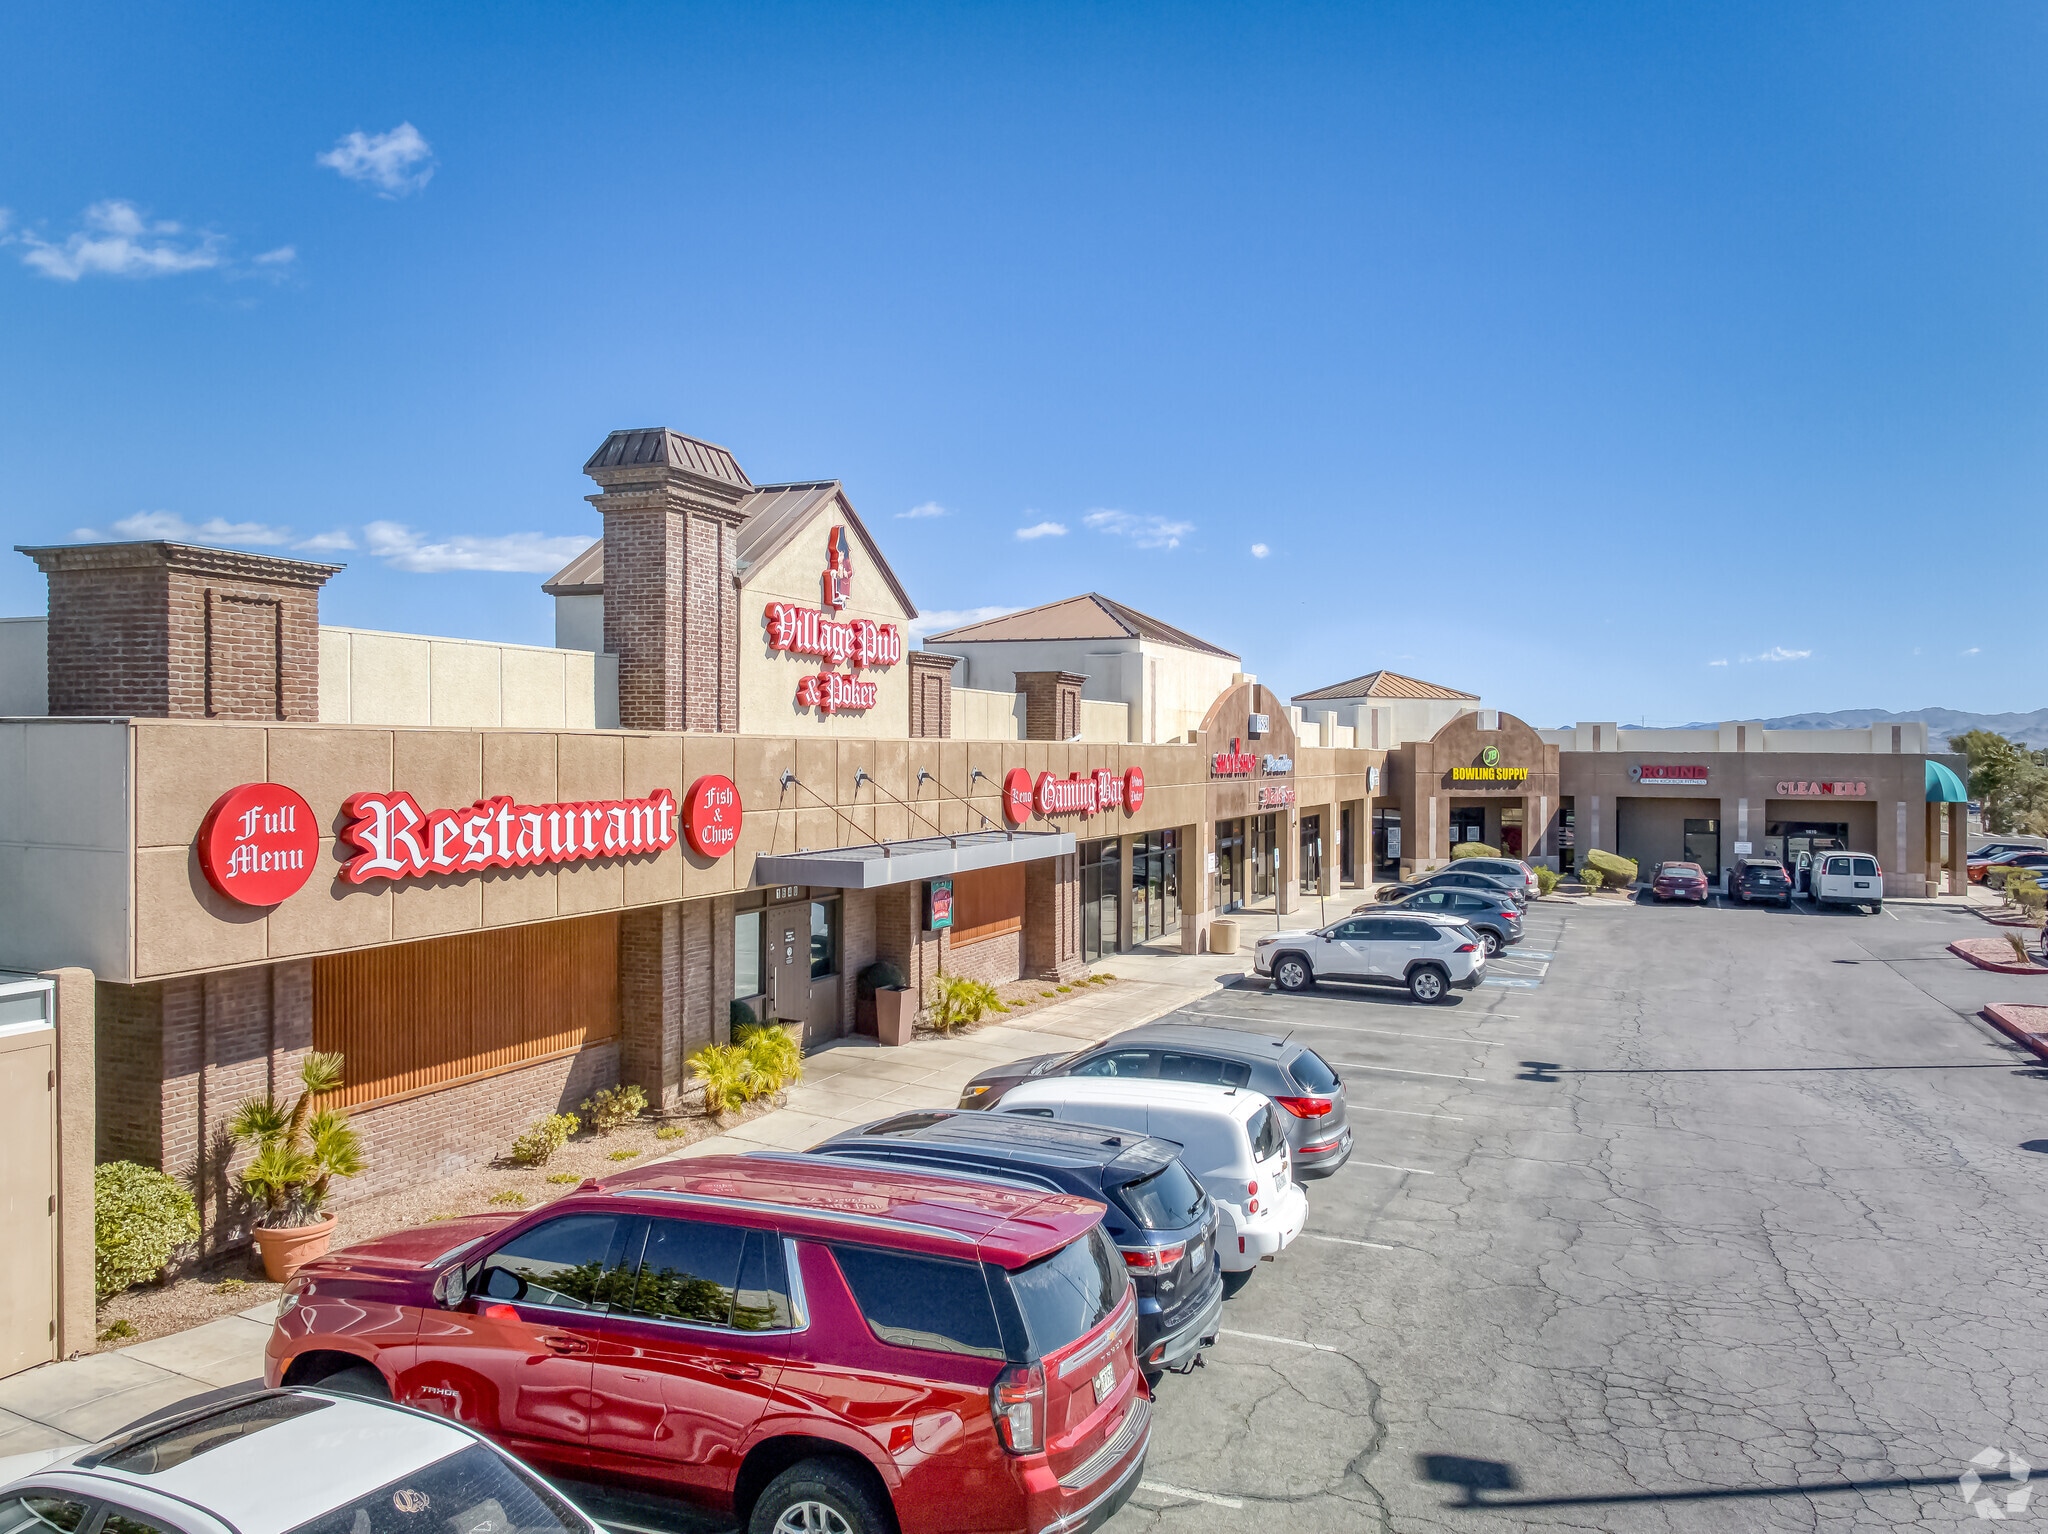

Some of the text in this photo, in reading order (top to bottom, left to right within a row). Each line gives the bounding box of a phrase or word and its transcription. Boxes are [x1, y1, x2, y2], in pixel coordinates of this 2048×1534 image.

[774, 605, 900, 666] Village Pub
[805, 674, 877, 711] & Poker
[1485, 749, 1497, 763] JB
[1452, 767, 1529, 780] BOWLING SUPPLY
[703, 787, 733, 809] Fish
[1012, 788, 1032, 804] Keno
[1041, 771, 1123, 810] Gaming Bar
[1777, 782, 1867, 800] CLEANERS
[235, 805, 297, 842] Full
[713, 807, 723, 822] &
[356, 795, 673, 876] Restaurant
[702, 824, 734, 846] Chips
[226, 843, 304, 879] Menu
[421, 1385, 460, 1397] TAHOE
